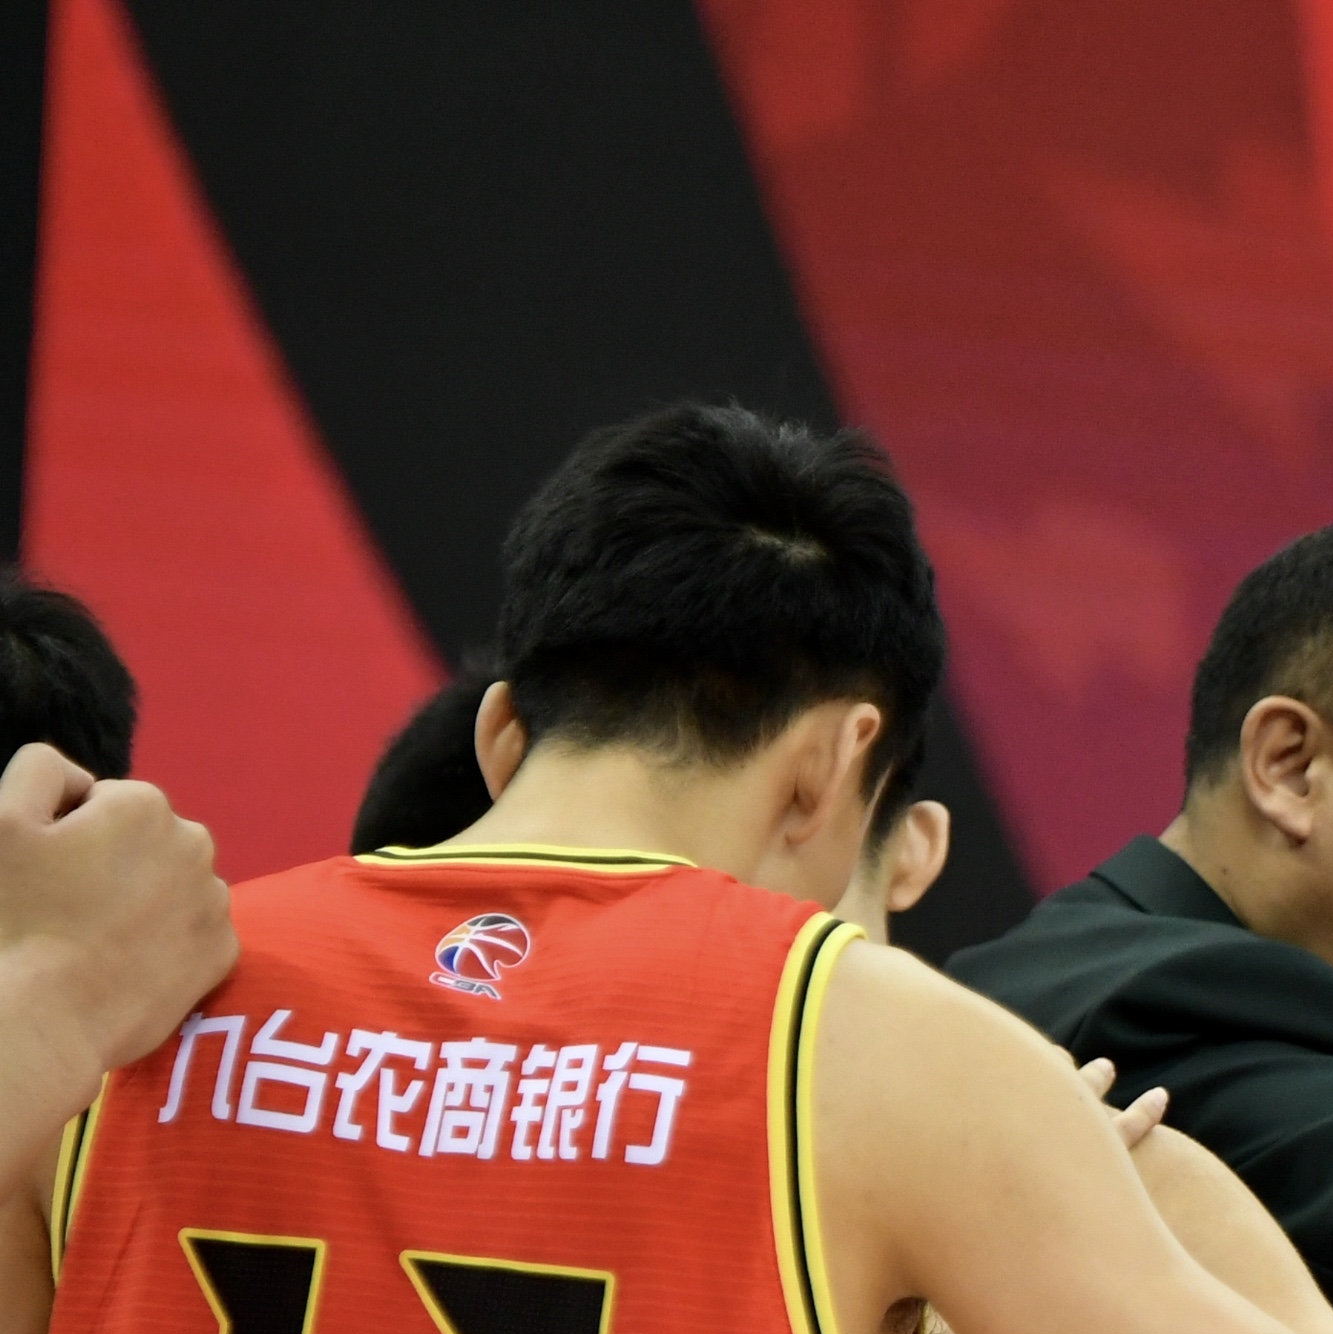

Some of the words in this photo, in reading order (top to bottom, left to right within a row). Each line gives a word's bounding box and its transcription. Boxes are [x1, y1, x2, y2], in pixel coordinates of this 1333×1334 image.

[158, 1008, 693, 1165] 九台农商银行
